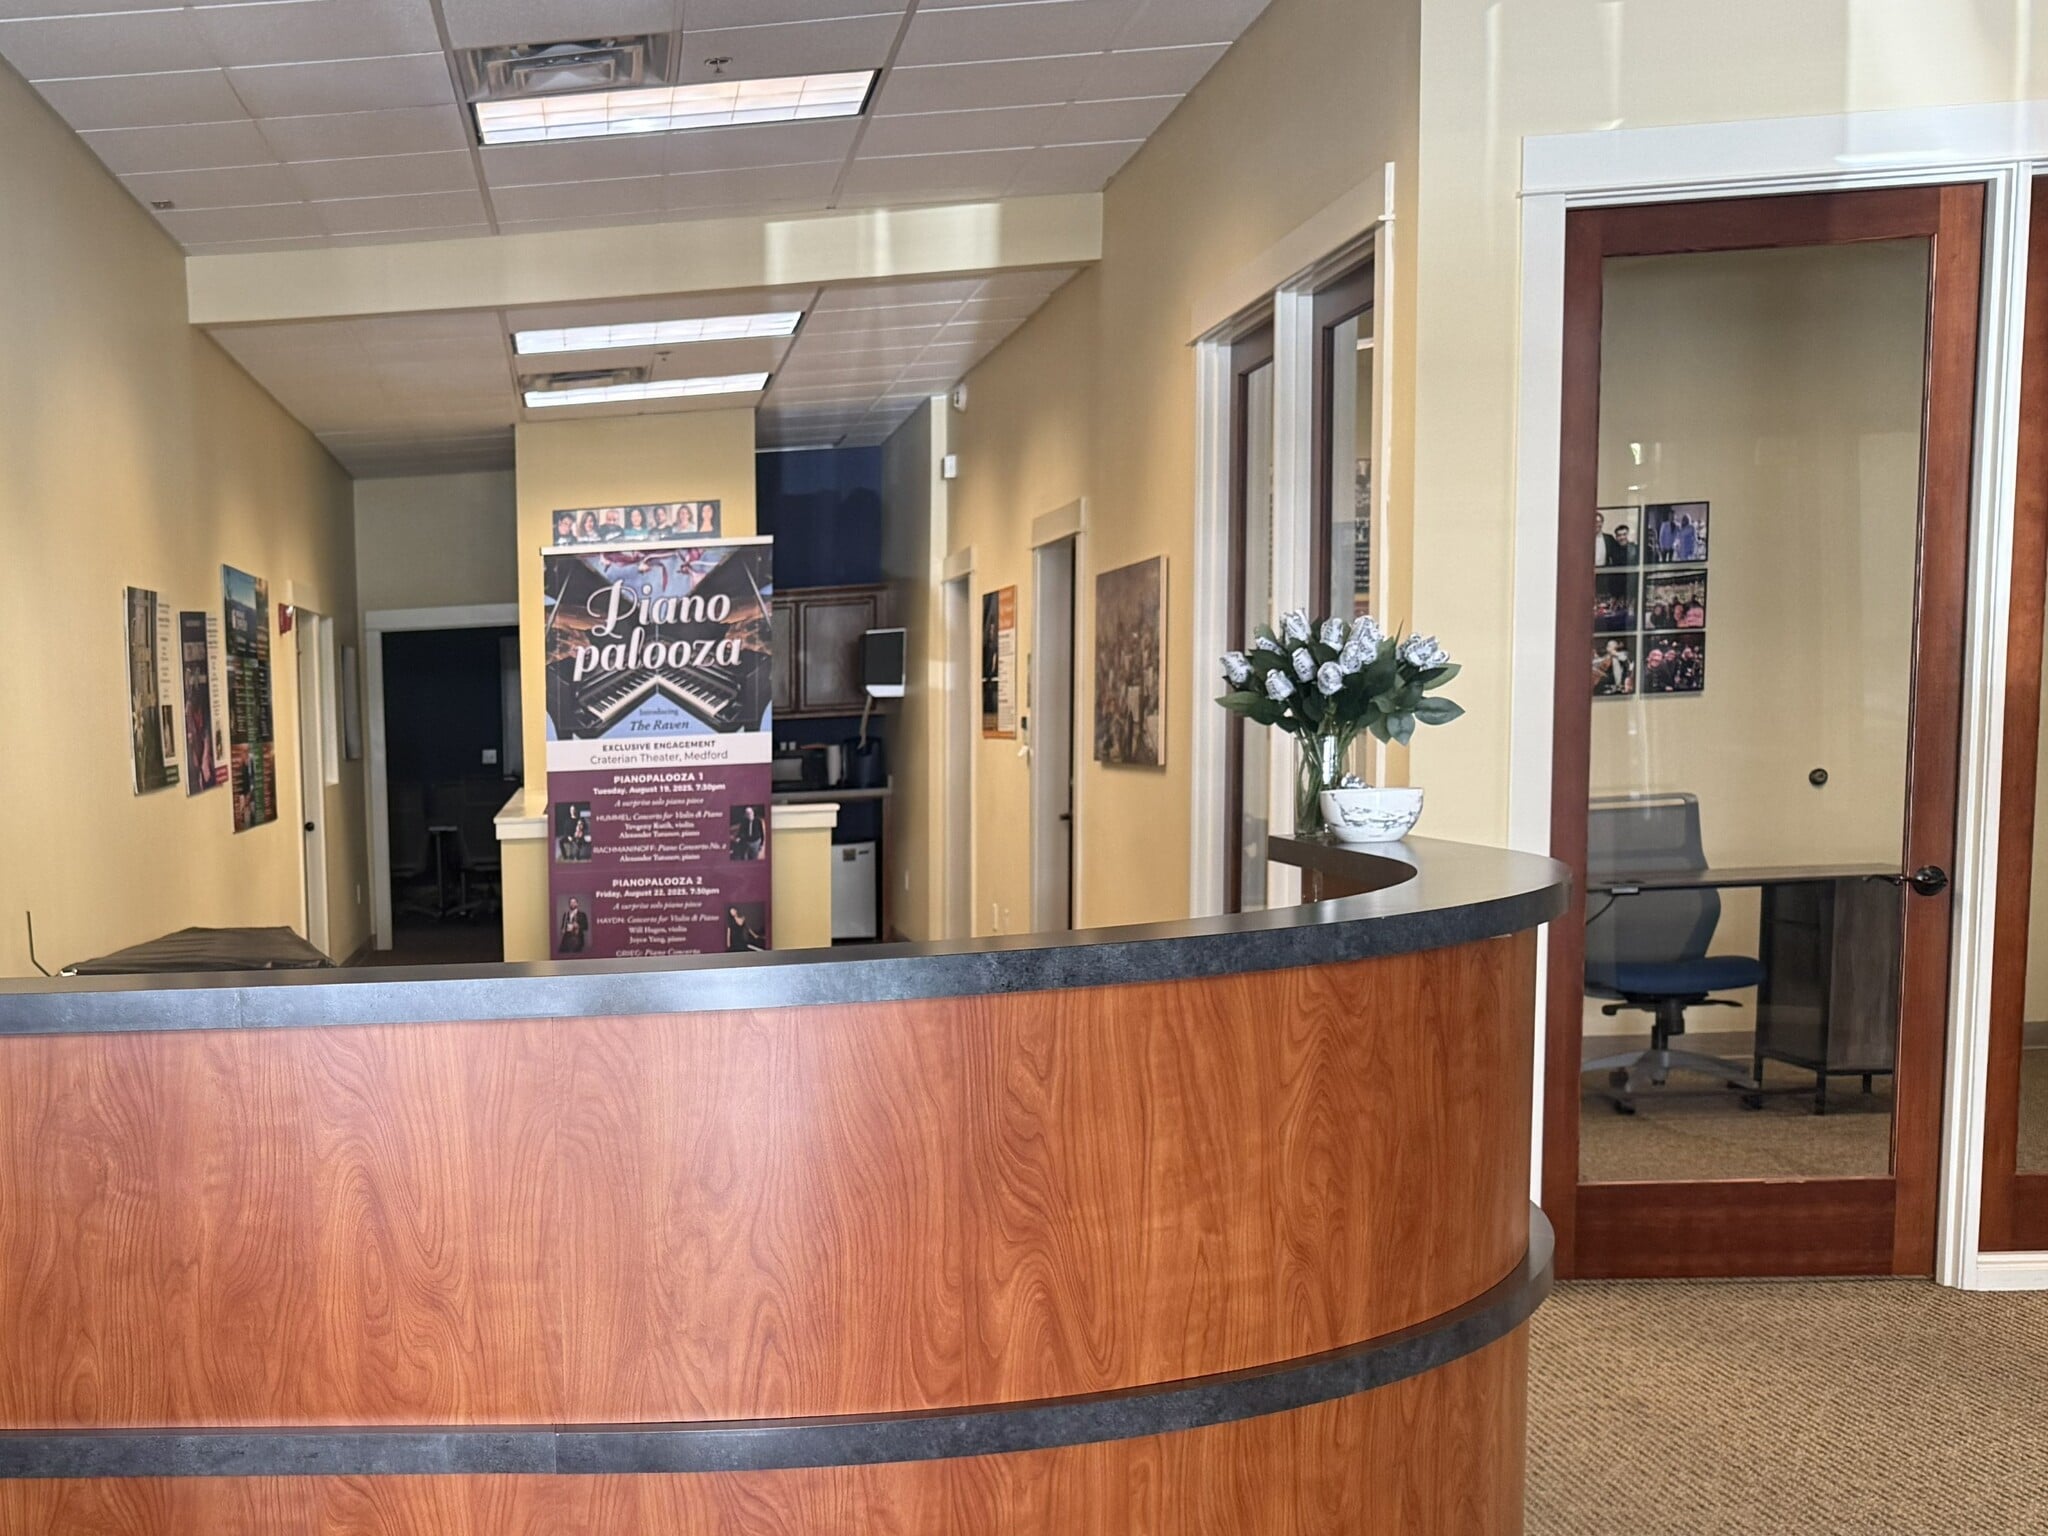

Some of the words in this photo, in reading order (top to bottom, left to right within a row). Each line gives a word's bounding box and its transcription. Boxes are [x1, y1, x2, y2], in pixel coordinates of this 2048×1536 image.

[587, 579, 730, 638] Piano
[573, 626, 742, 681] palooza
[640, 708, 678, 716] Introducing
[630, 721, 650, 732] The
[653, 720, 689, 730] Raven
[602, 743, 650, 752] EXCLUSIVE
[654, 740, 716, 750] ENGAGEMENT
[590, 754, 638, 766] Craterian
[640, 752, 682, 764] Theater,
[684, 750, 728, 760] Medford
[614, 773, 695, 784] PIANOPALOOZA
[629, 785, 658, 795] August
[612, 877, 694, 887] PIANOPALOOZA
[624, 889, 652, 898] August
